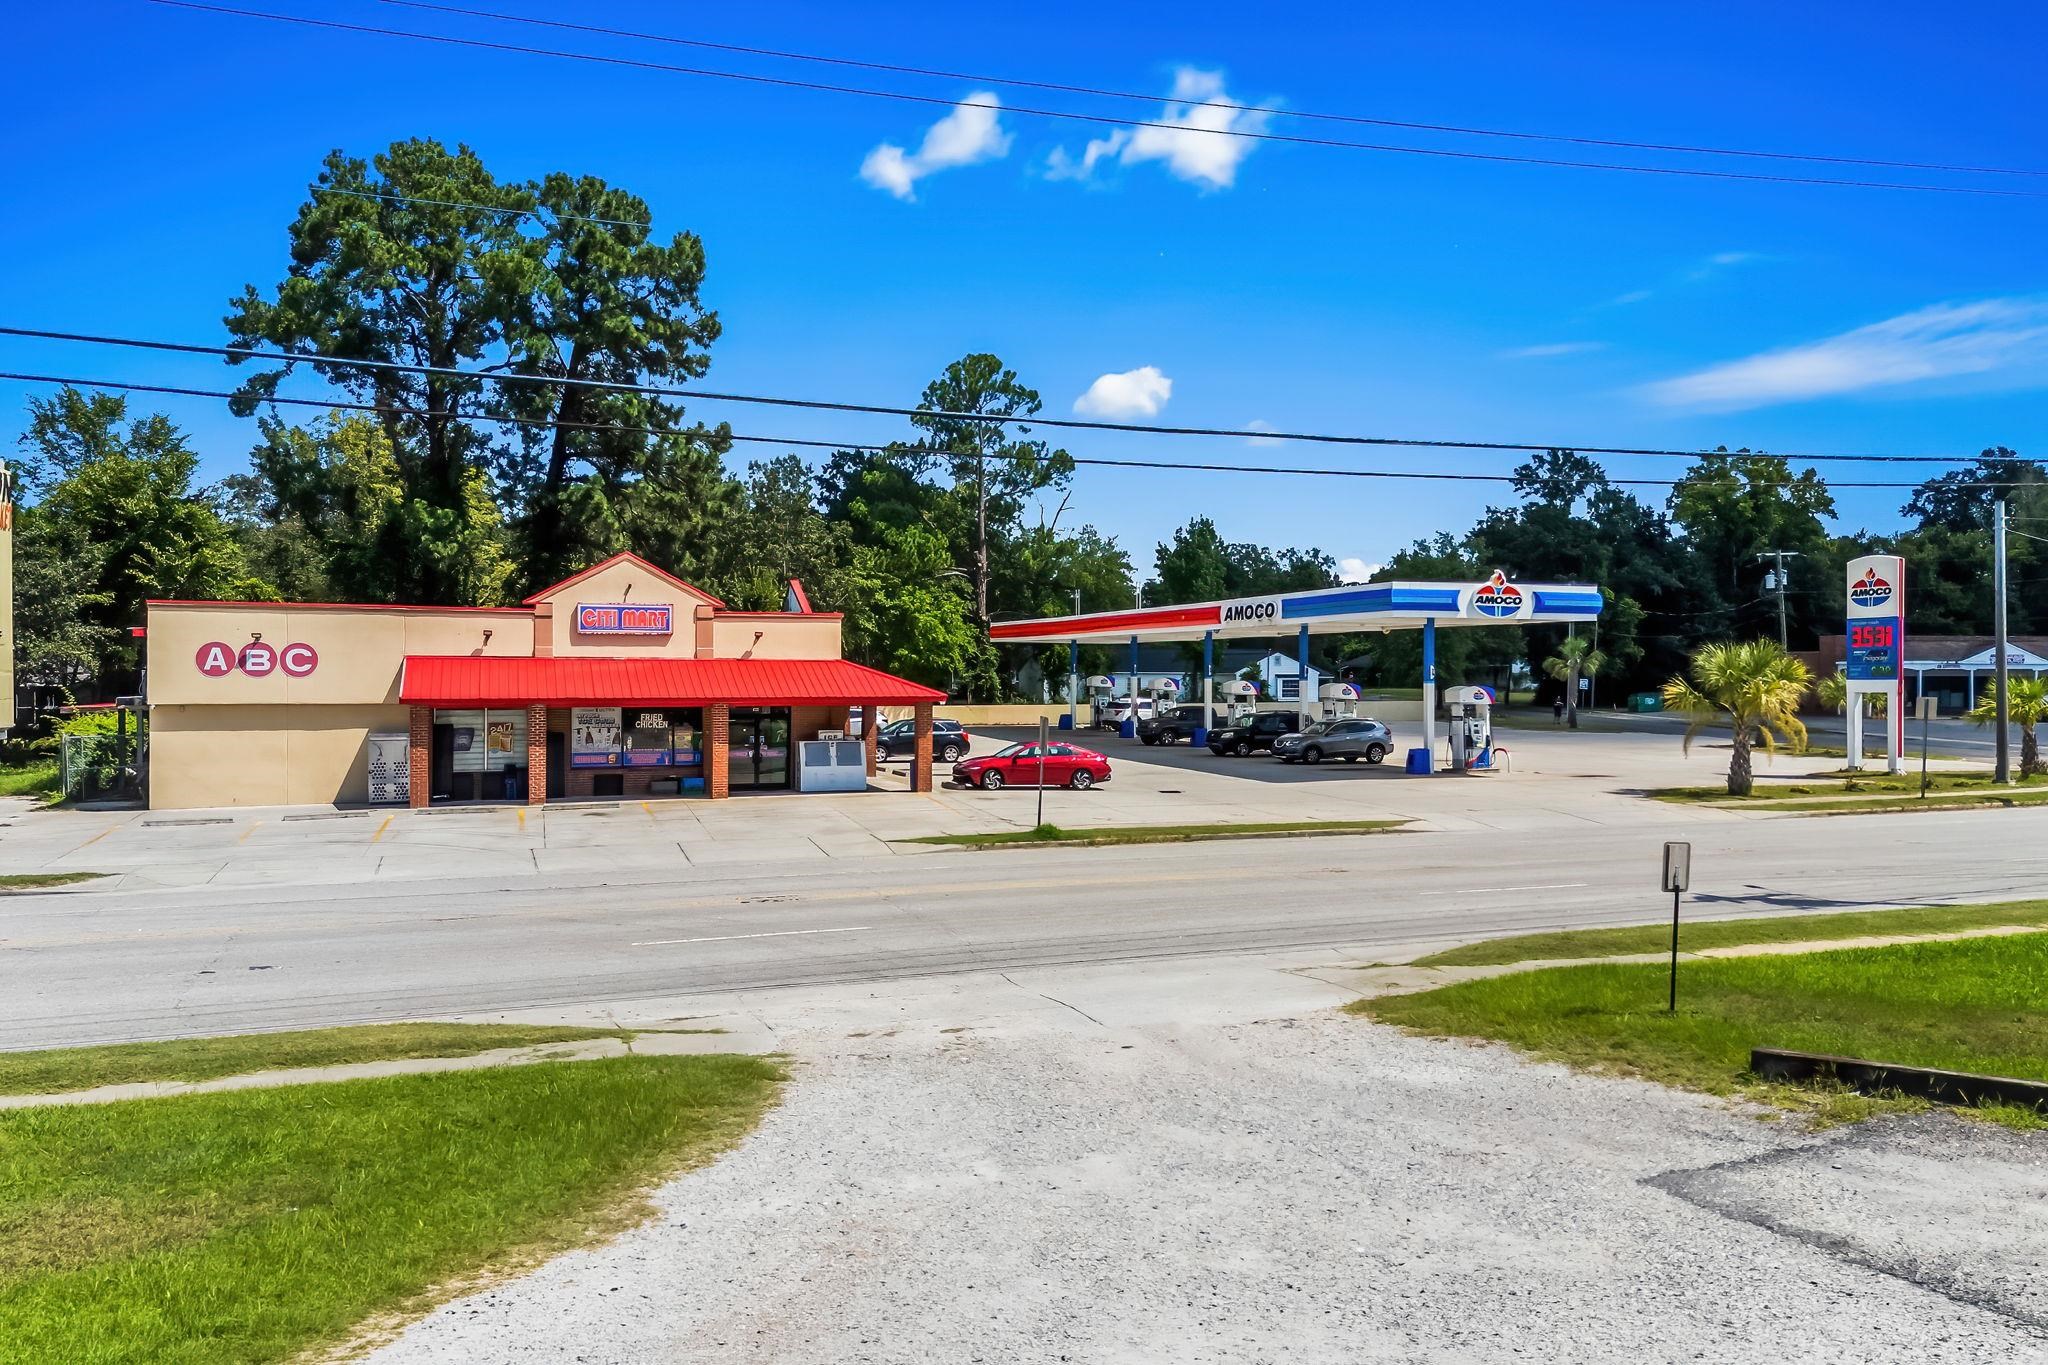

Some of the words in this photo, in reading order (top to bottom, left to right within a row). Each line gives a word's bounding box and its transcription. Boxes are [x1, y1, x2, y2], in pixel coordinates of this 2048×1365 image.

[1851, 588, 1892, 597] AMOCO
[1475, 596, 1522, 605] AMOCO
[1224, 603, 1275, 621] AMOCO
[582, 609, 619, 628] CITI
[622, 610, 668, 629] MART
[641, 713, 663, 721] FRIED
[635, 720, 669, 728] CHICKEN
